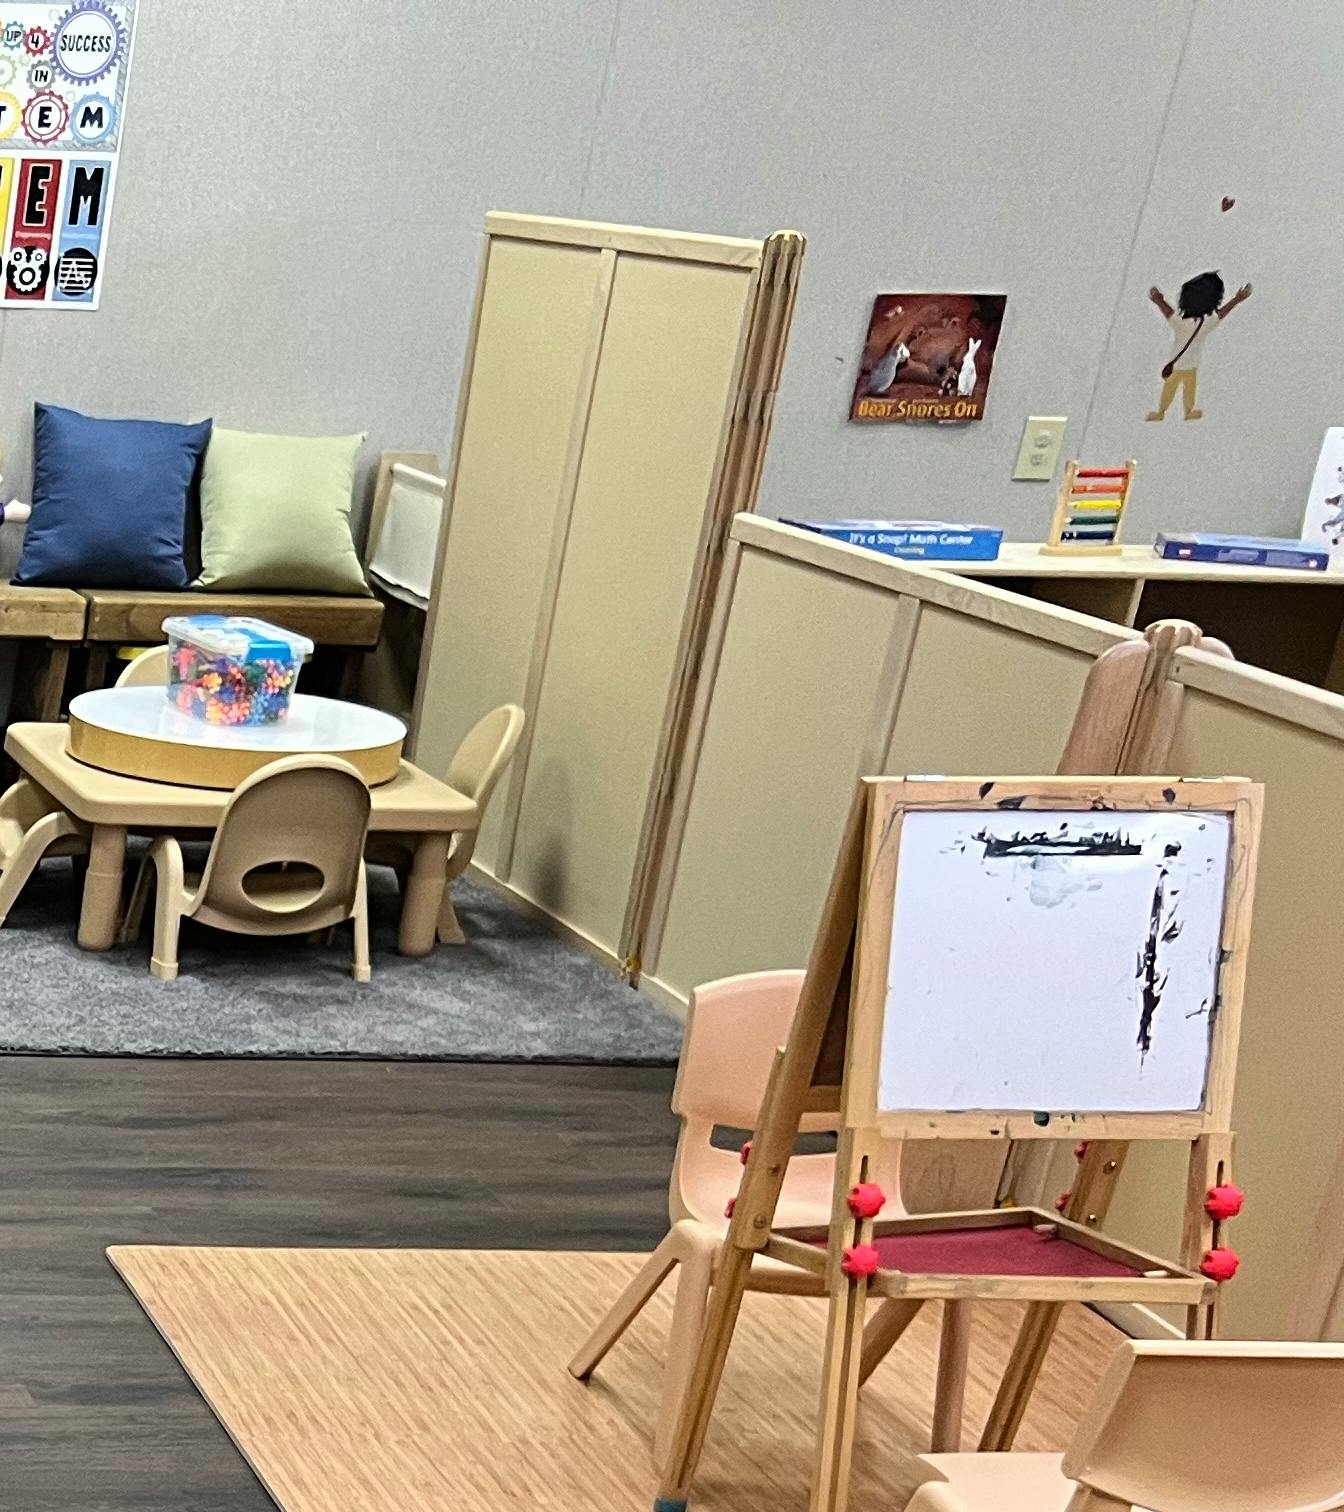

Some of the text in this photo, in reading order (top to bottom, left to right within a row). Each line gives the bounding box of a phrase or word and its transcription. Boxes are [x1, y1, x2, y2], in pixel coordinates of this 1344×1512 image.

[6, 31, 22, 41] UP
[31, 35, 40, 48] 4
[61, 35, 111, 52] SUCCESS
[34, 70, 48, 82] IN
[858, 400, 978, 417] Bear Snores On
[850, 533, 973, 546] It's a Snap! Math Center
